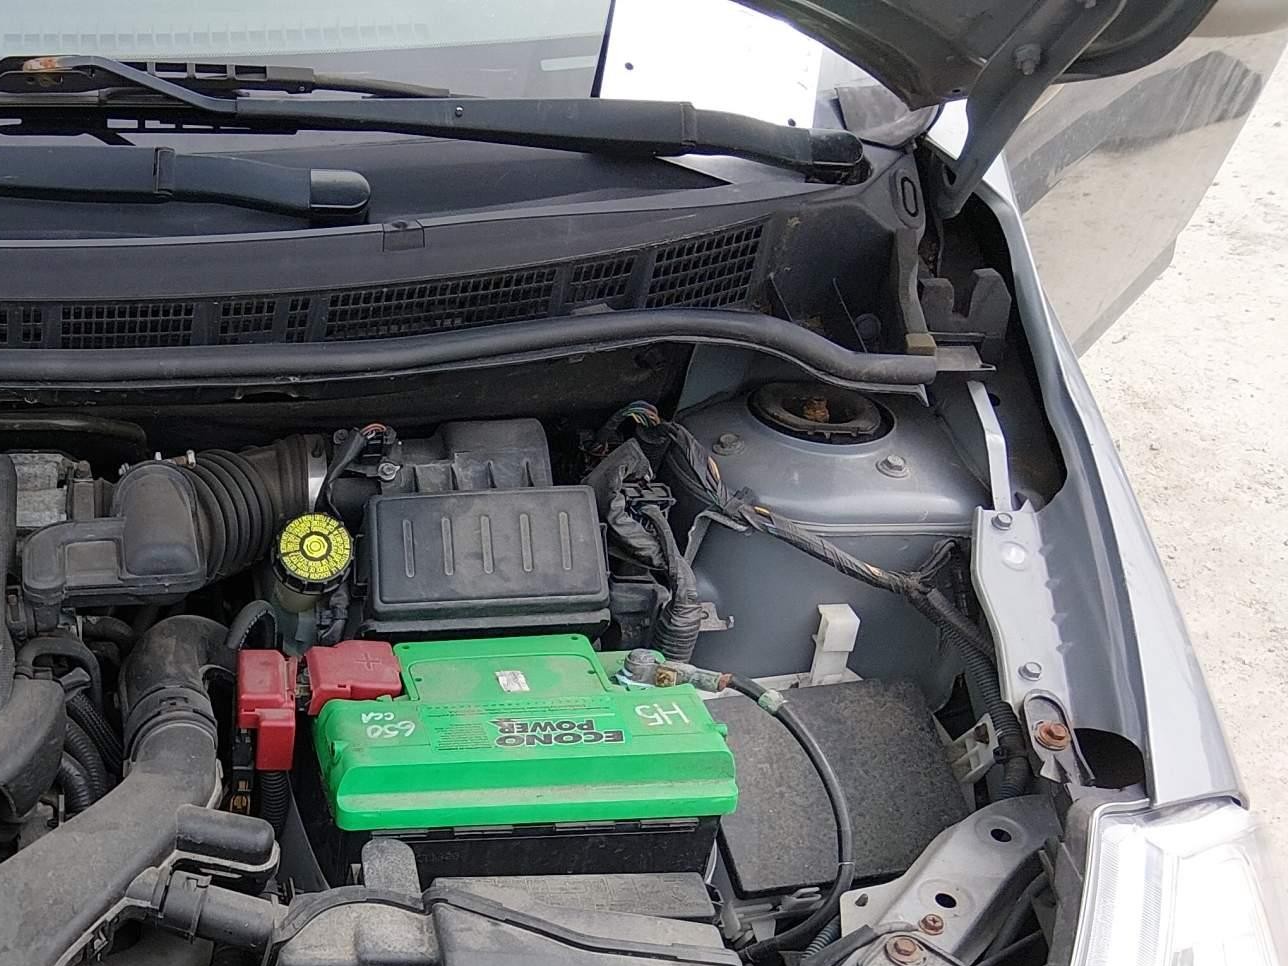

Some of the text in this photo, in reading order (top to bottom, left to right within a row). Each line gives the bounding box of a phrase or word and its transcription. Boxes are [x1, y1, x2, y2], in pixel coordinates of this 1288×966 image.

[366, 720, 416, 739] 650
[498, 718, 595, 734] POWER
[495, 730, 625, 747] ECONO
